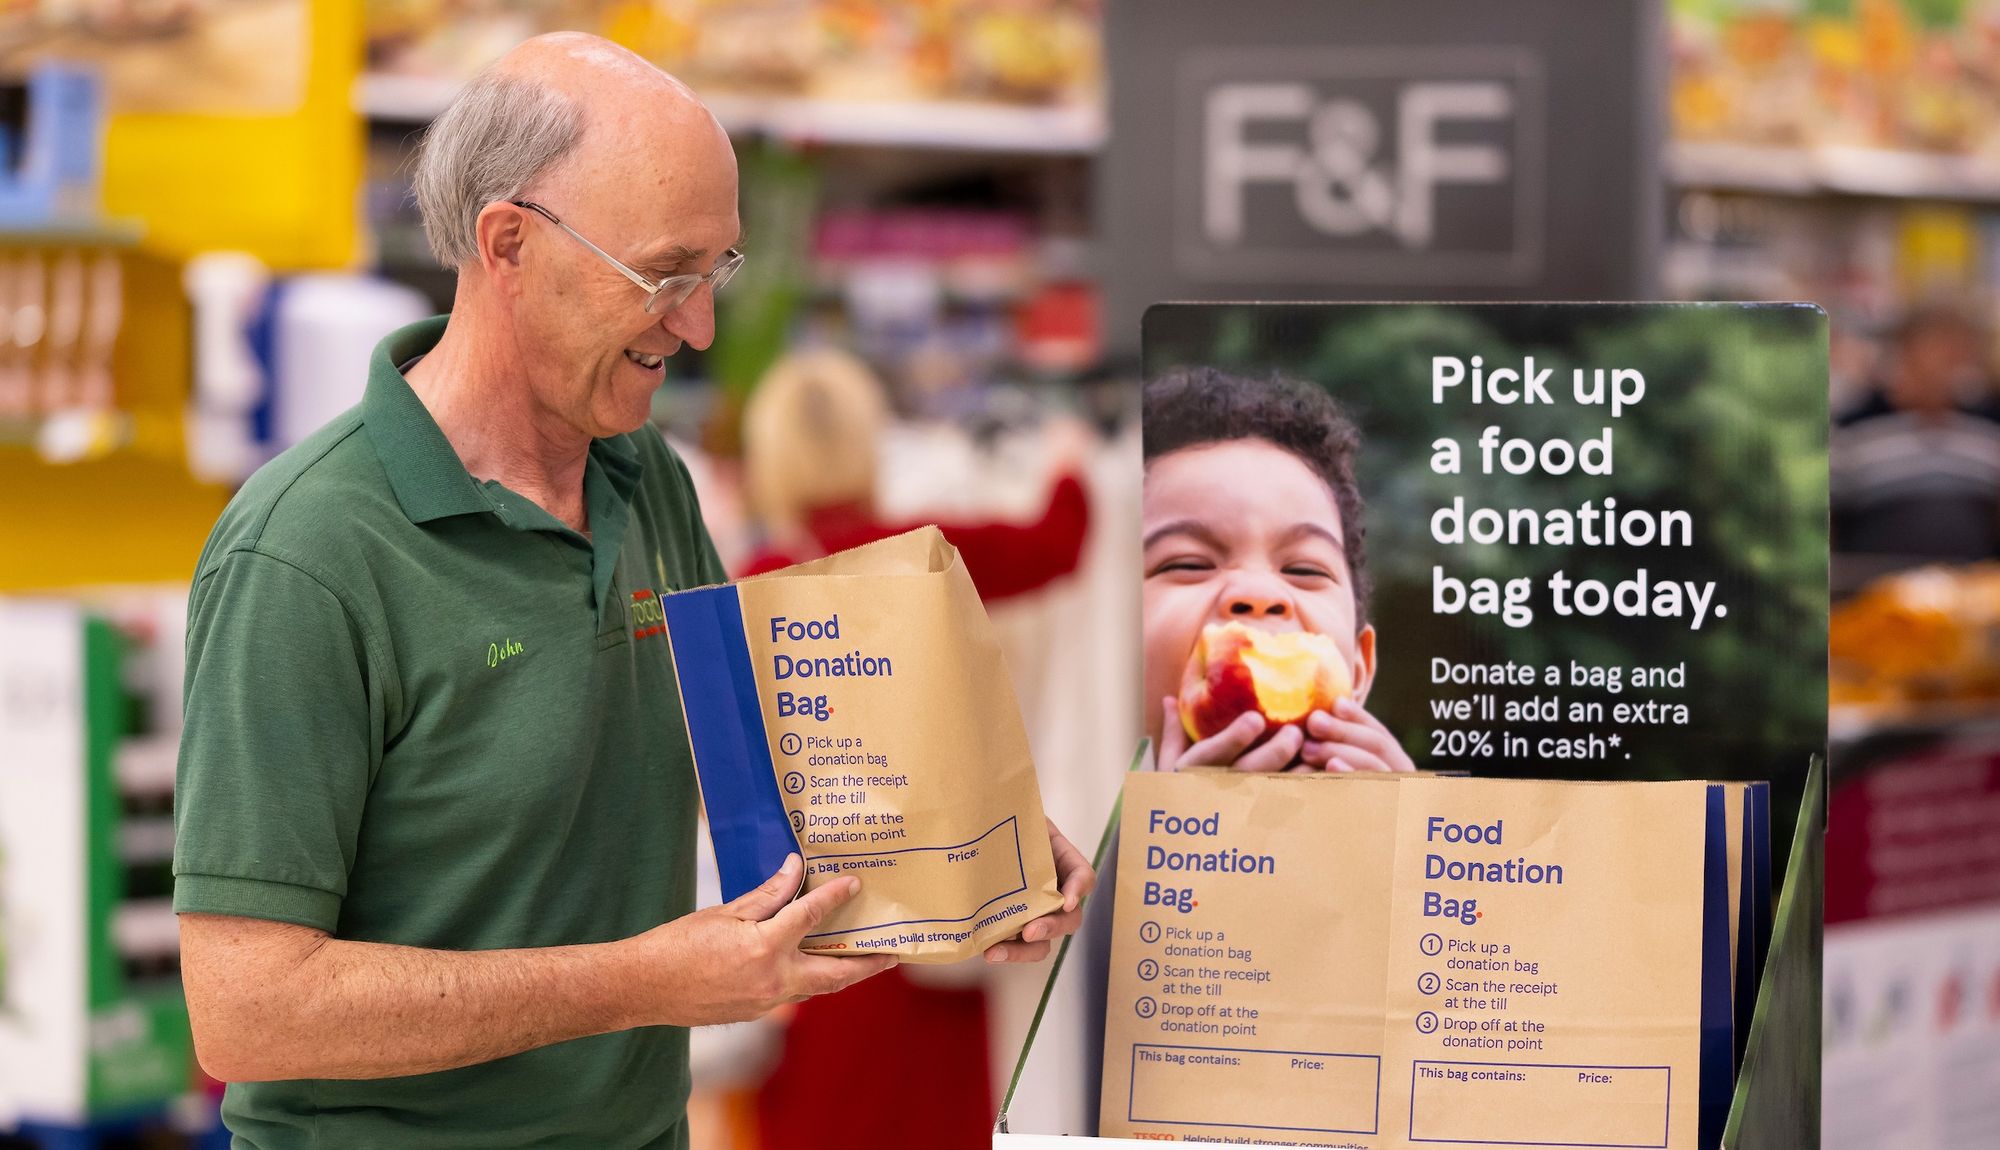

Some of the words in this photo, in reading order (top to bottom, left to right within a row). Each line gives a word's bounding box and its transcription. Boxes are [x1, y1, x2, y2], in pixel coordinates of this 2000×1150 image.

[1206, 82, 1509, 247] F&F
[1431, 355, 1554, 405] Pick
[1573, 368, 1646, 418] up
[1430, 438, 1461, 475] a
[1478, 425, 1613, 476] food
[1430, 496, 1693, 547] donation
[1432, 566, 1533, 628] bag
[1548, 568, 1728, 630] today.
[770, 614, 840, 643] Food
[487, 638, 524, 668] John
[773, 651, 893, 680] Donation
[1431, 657, 1536, 686] Donate
[1544, 666, 1561, 686] a
[1570, 659, 1622, 693] bag
[1630, 662, 1685, 688] and
[777, 691, 834, 721] Bag.
[1504, 696, 1558, 723] add
[1568, 703, 1602, 723] an
[1613, 701, 1690, 725] extra
[807, 736, 833, 749] Pick
[836, 737, 853, 750] up
[855, 738, 862, 748] a
[1430, 729, 1494, 758] 20%
[1503, 732, 1528, 758] in
[808, 753, 864, 766] donation
[867, 753, 888, 768] bag
[810, 776, 838, 788] Scan
[843, 774, 864, 787] the
[867, 774, 909, 789] receipt
[810, 793, 822, 806] at
[825, 792, 847, 805] the
[850, 791, 866, 804] till
[809, 814, 839, 829] Drop
[842, 813, 861, 826] off
[864, 813, 878, 825] at
[880, 813, 904, 824] the
[1148, 809, 1220, 836] Food
[1426, 816, 1503, 845] Food
[808, 831, 867, 844] donation
[871, 828, 907, 843] point
[818, 863, 840, 873] bag
[842, 858, 897, 870] contains:
[947, 848, 979, 863] Price:
[1146, 846, 1276, 875] Donation
[1424, 854, 1563, 884] Donation
[1143, 881, 1199, 914] Bag.
[1423, 892, 1483, 926] Bag.
[855, 936, 897, 949] Helping
[898, 933, 925, 944] build
[927, 930, 972, 943] stronger
[1165, 927, 1192, 940] Pick
[1196, 931, 1213, 943] up
[1217, 932, 1225, 941] a
[1164, 944, 1223, 958] donation
[1228, 947, 1252, 962] bag
[1448, 939, 1476, 953] Pick
[1481, 943, 1498, 956] up
[1503, 944, 1511, 954] a
[1163, 965, 1194, 978] Scan
[1198, 967, 1220, 979] the
[1224, 968, 1271, 984] receipt
[1447, 957, 1509, 971] donation
[1514, 960, 1539, 975] bag
[1162, 983, 1176, 994] at
[1180, 982, 1202, 995] the
[1206, 983, 1222, 996] till
[1446, 978, 1479, 992] Scan
[1483, 980, 1506, 993] the
[1509, 982, 1558, 997] receipt
[1161, 1002, 1194, 1018] Drop
[1197, 1004, 1216, 1017] off
[1219, 1007, 1232, 1018] at
[1236, 1006, 1259, 1019] the
[1445, 997, 1458, 1009] at
[1463, 997, 1486, 1010] the
[1490, 997, 1507, 1010] till
[1160, 1019, 1219, 1034] donation
[1222, 1022, 1257, 1037] point
[1444, 1017, 1477, 1033] Drop
[1481, 1019, 1501, 1032] off
[1504, 1020, 1518, 1032] at
[1522, 1020, 1545, 1033] the
[1442, 1035, 1503, 1049] donation
[1507, 1037, 1543, 1052] point
[1138, 1050, 1162, 1062] This
[1165, 1052, 1186, 1066] bag
[1188, 1053, 1241, 1066] contains:
[1291, 1058, 1325, 1071] Price:
[1419, 1067, 1443, 1079] This
[1447, 1068, 1468, 1082] bag
[1471, 1069, 1526, 1081] contains:
[1578, 1072, 1613, 1085] Price:
